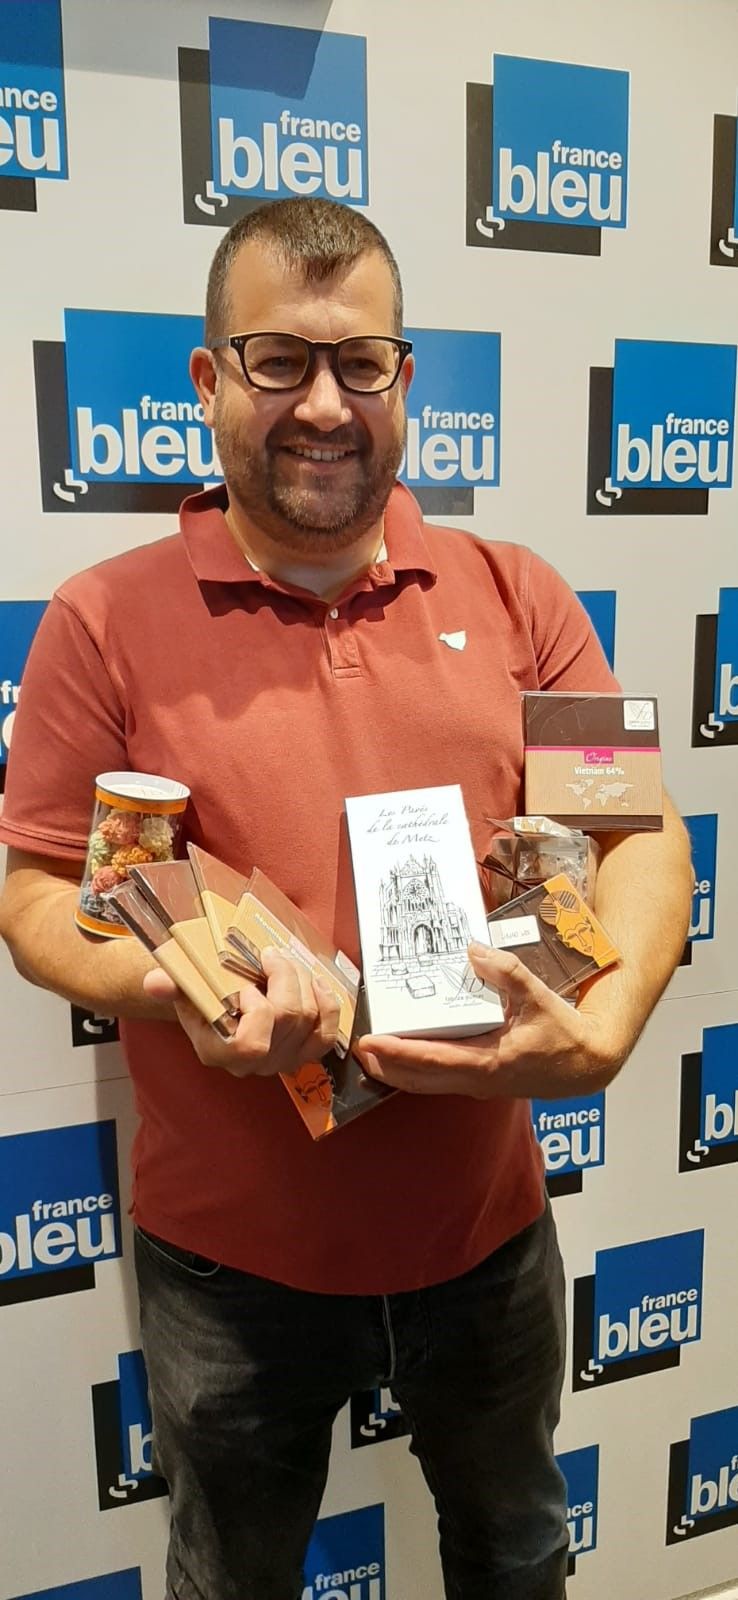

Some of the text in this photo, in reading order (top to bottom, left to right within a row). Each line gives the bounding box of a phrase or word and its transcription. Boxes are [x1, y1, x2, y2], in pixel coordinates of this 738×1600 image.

[0, 87, 57, 112] nce
[280, 110, 361, 142] france
[219, 118, 362, 198] bleu
[552, 140, 622, 169] france
[499, 147, 622, 221] bleu
[140, 395, 206, 421] franc
[422, 405, 495, 430] france
[666, 413, 729, 435] france
[77, 407, 225, 477] bleu
[396, 418, 495, 481] leu
[617, 424, 729, 483] bleu
[574, 766, 625, 776] Vietnam 64%
[402, 834, 440, 844] Metz
[539, 1108, 601, 1131] france
[533, 1124, 601, 1170] eu
[32, 1193, 113, 1221] france
[642, 1288, 698, 1312] france
[599, 1304, 698, 1360] bleu
[315, 1562, 380, 1591] france
